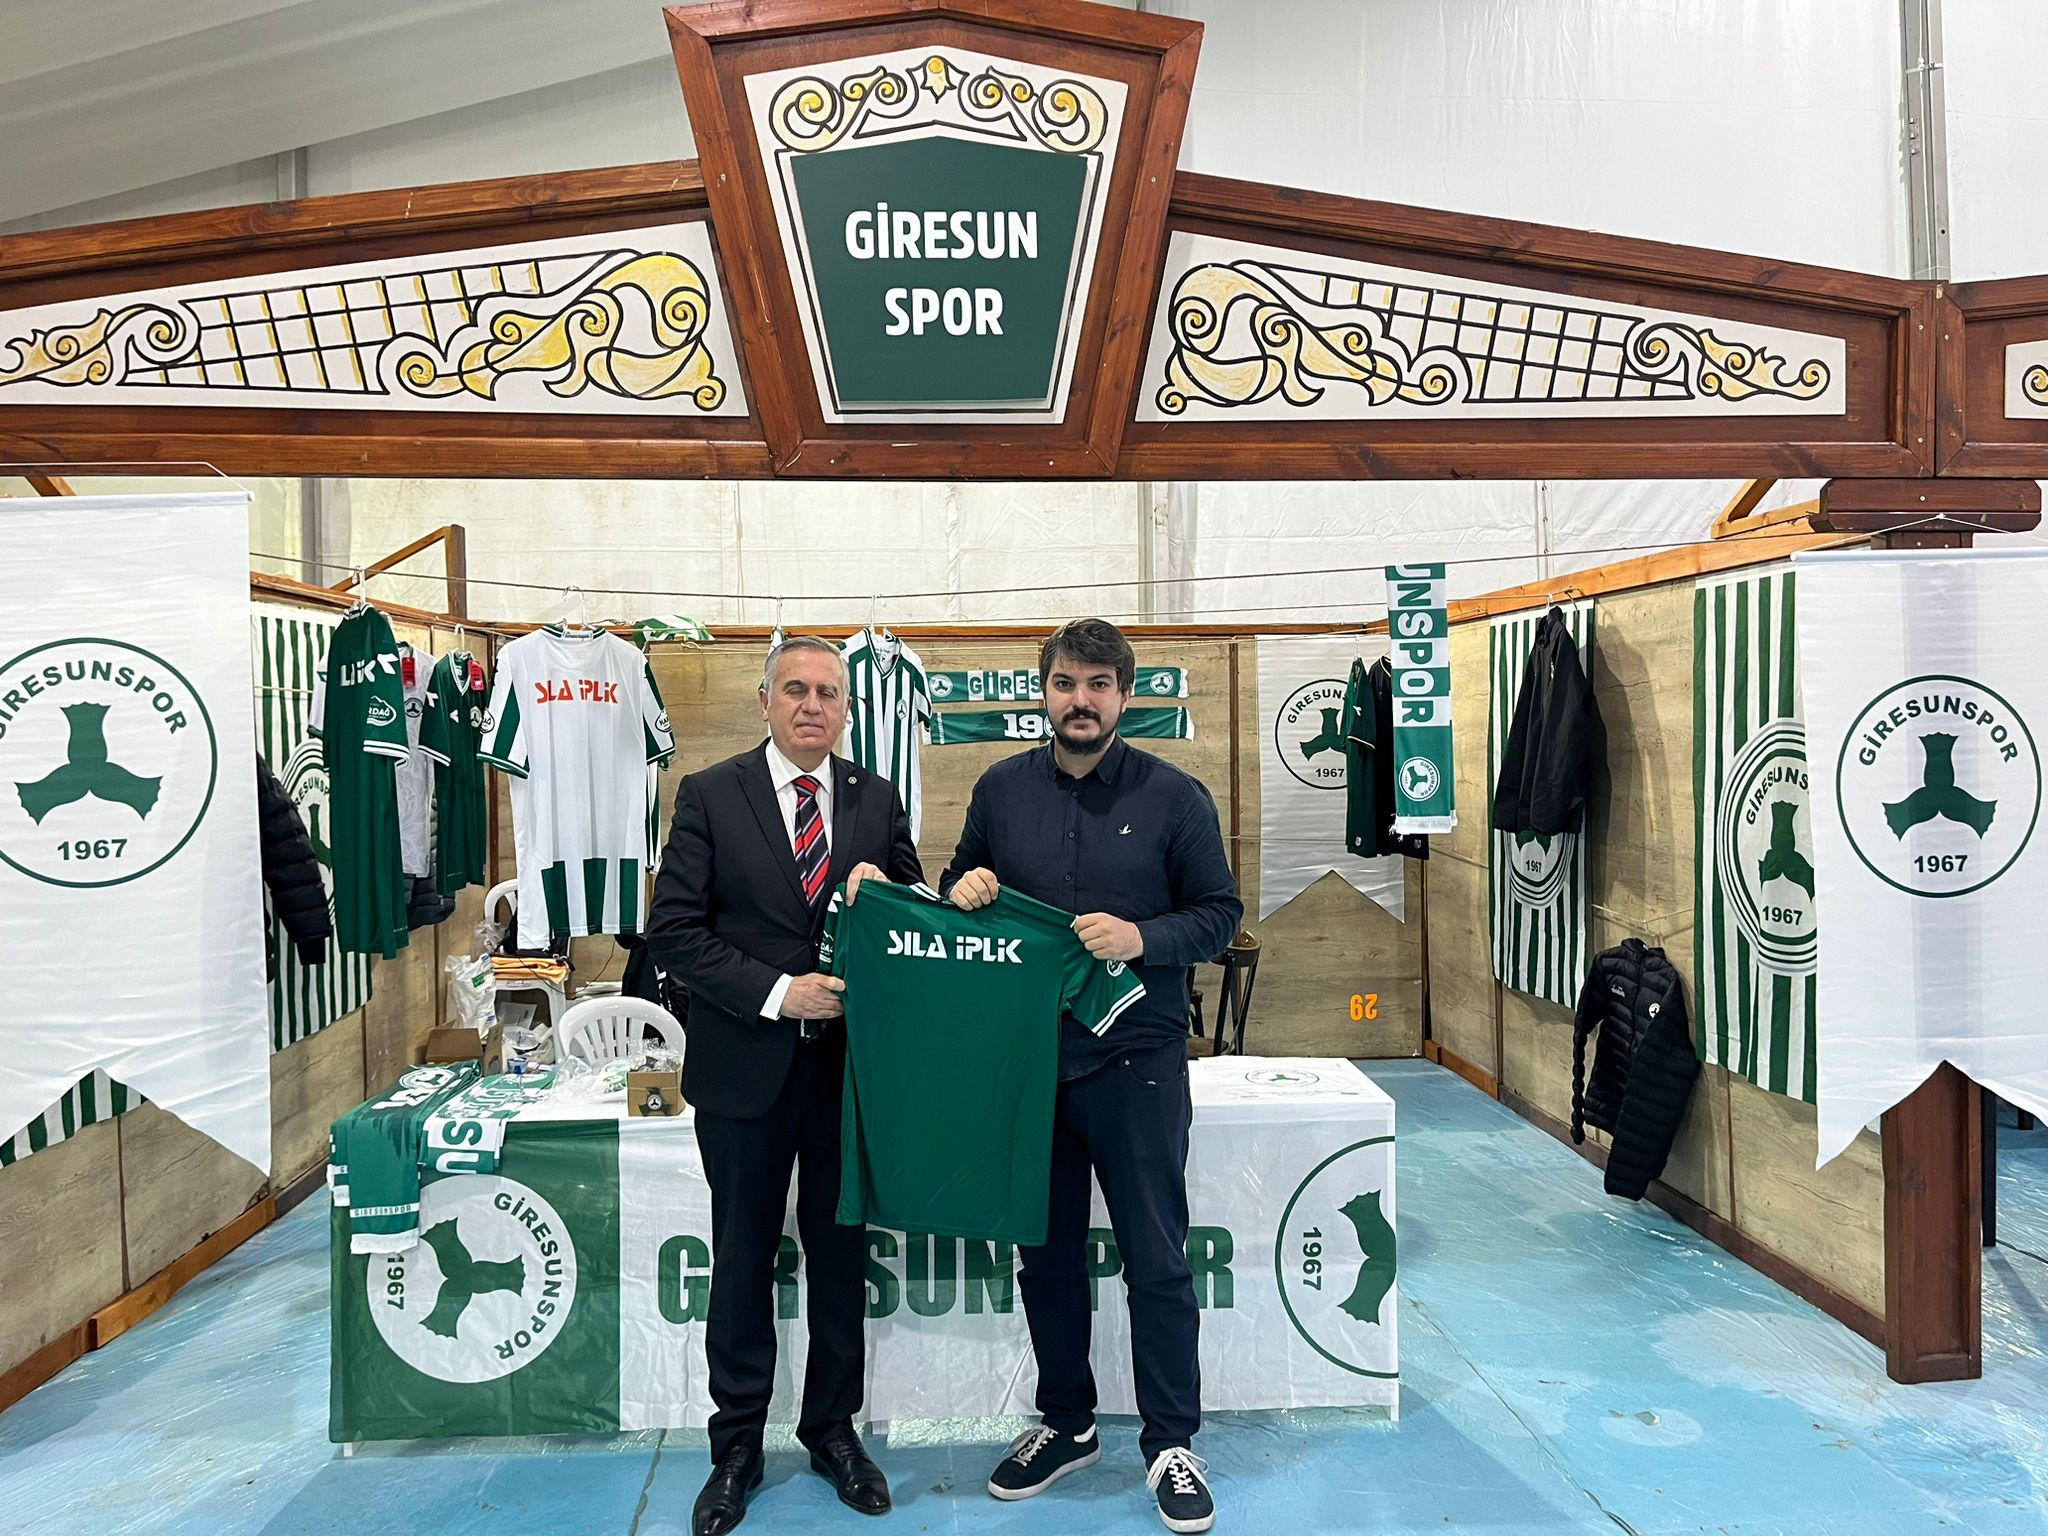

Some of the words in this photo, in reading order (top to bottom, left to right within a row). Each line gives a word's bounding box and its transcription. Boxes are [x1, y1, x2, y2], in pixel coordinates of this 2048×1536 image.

[845, 202, 1038, 259] GİRESUN
[884, 287, 1003, 336] SPOR
[1287, 689, 1346, 725] GİRESUN
[1858, 695, 2019, 767] GİRESUNSPOR
[1315, 768, 1345, 778] 1967
[57, 838, 128, 860] 1967
[1913, 855, 1968, 873] 1967
[1762, 905, 1803, 926] 1967
[887, 930, 948, 959] SILA
[493, 1192, 563, 1360] GİRESUNSPOR
[1302, 1226, 1323, 1291] 1967
[387, 1253, 405, 1310] 1967
